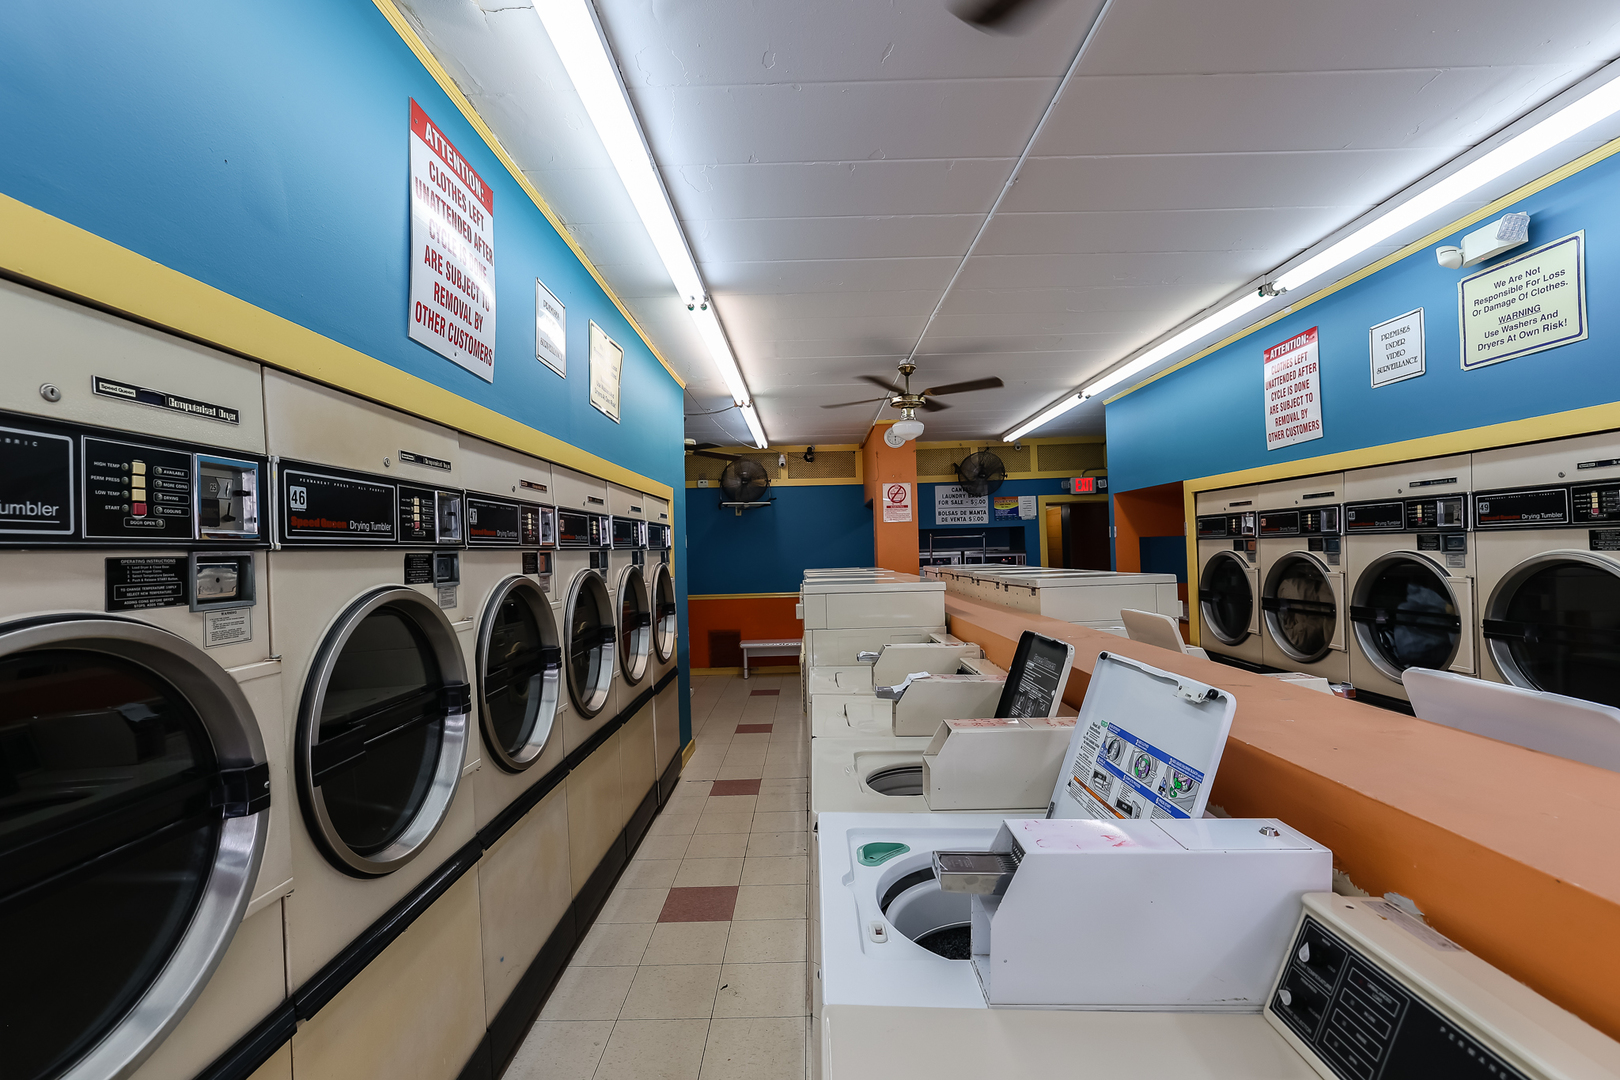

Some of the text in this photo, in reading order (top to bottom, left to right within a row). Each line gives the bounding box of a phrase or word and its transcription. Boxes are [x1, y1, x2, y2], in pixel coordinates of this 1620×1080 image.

[425, 122, 485, 202] ATTENTION:
[429, 161, 484, 232] CLOTHES LEFT
[415, 176, 493, 266] UNATTENDED AFTER
[429, 218, 487, 283] CYCLE IS DONE
[424, 245, 490, 312] ARE SUBJECT TO
[1473, 269, 1566, 307] Responsible For Loss
[1493, 266, 1541, 289] We Are Not
[434, 281, 483, 333] REMOVAL BY
[1472, 280, 1569, 317] Or Damage Of Clothes.
[1484, 310, 1559, 339] Use Washers And
[1498, 304, 1541, 324] WARNING
[415, 301, 493, 366] OTHER CUSTOMERS
[1381, 325, 1411, 341] PREMISES
[1385, 338, 1406, 350] UNDER
[1477, 318, 1568, 352] Dryers At Own Risk!
[1270, 333, 1309, 359] ATTENTION:
[1386, 349, 1406, 360] VIDEO
[1271, 351, 1308, 375] CLOTHES LEFT
[1376, 356, 1418, 374] SURVEILLANCE
[1266, 362, 1317, 390] UNATTENDED AFTER
[101, 383, 135, 396] Speed Queen
[1271, 379, 1310, 401] CYCLE IS DONE
[169, 397, 236, 421] Computerised Dryer
[1270, 392, 1313, 415] ARE SUBJECT TO
[1275, 408, 1308, 427] REMOVAL BY
[0, 437, 38, 447] BRIC
[1268, 420, 1319, 442] OTHER CUSTOMERS
[1075, 477, 1094, 492] EXIT
[0, 501, 59, 516] umbler
[291, 489, 305, 505] 46
[1480, 503, 1489, 511] 49
[291, 516, 392, 532] Speed Queen Drying Tumbler
[1306, 966, 1333, 991] TEMPERATURE
